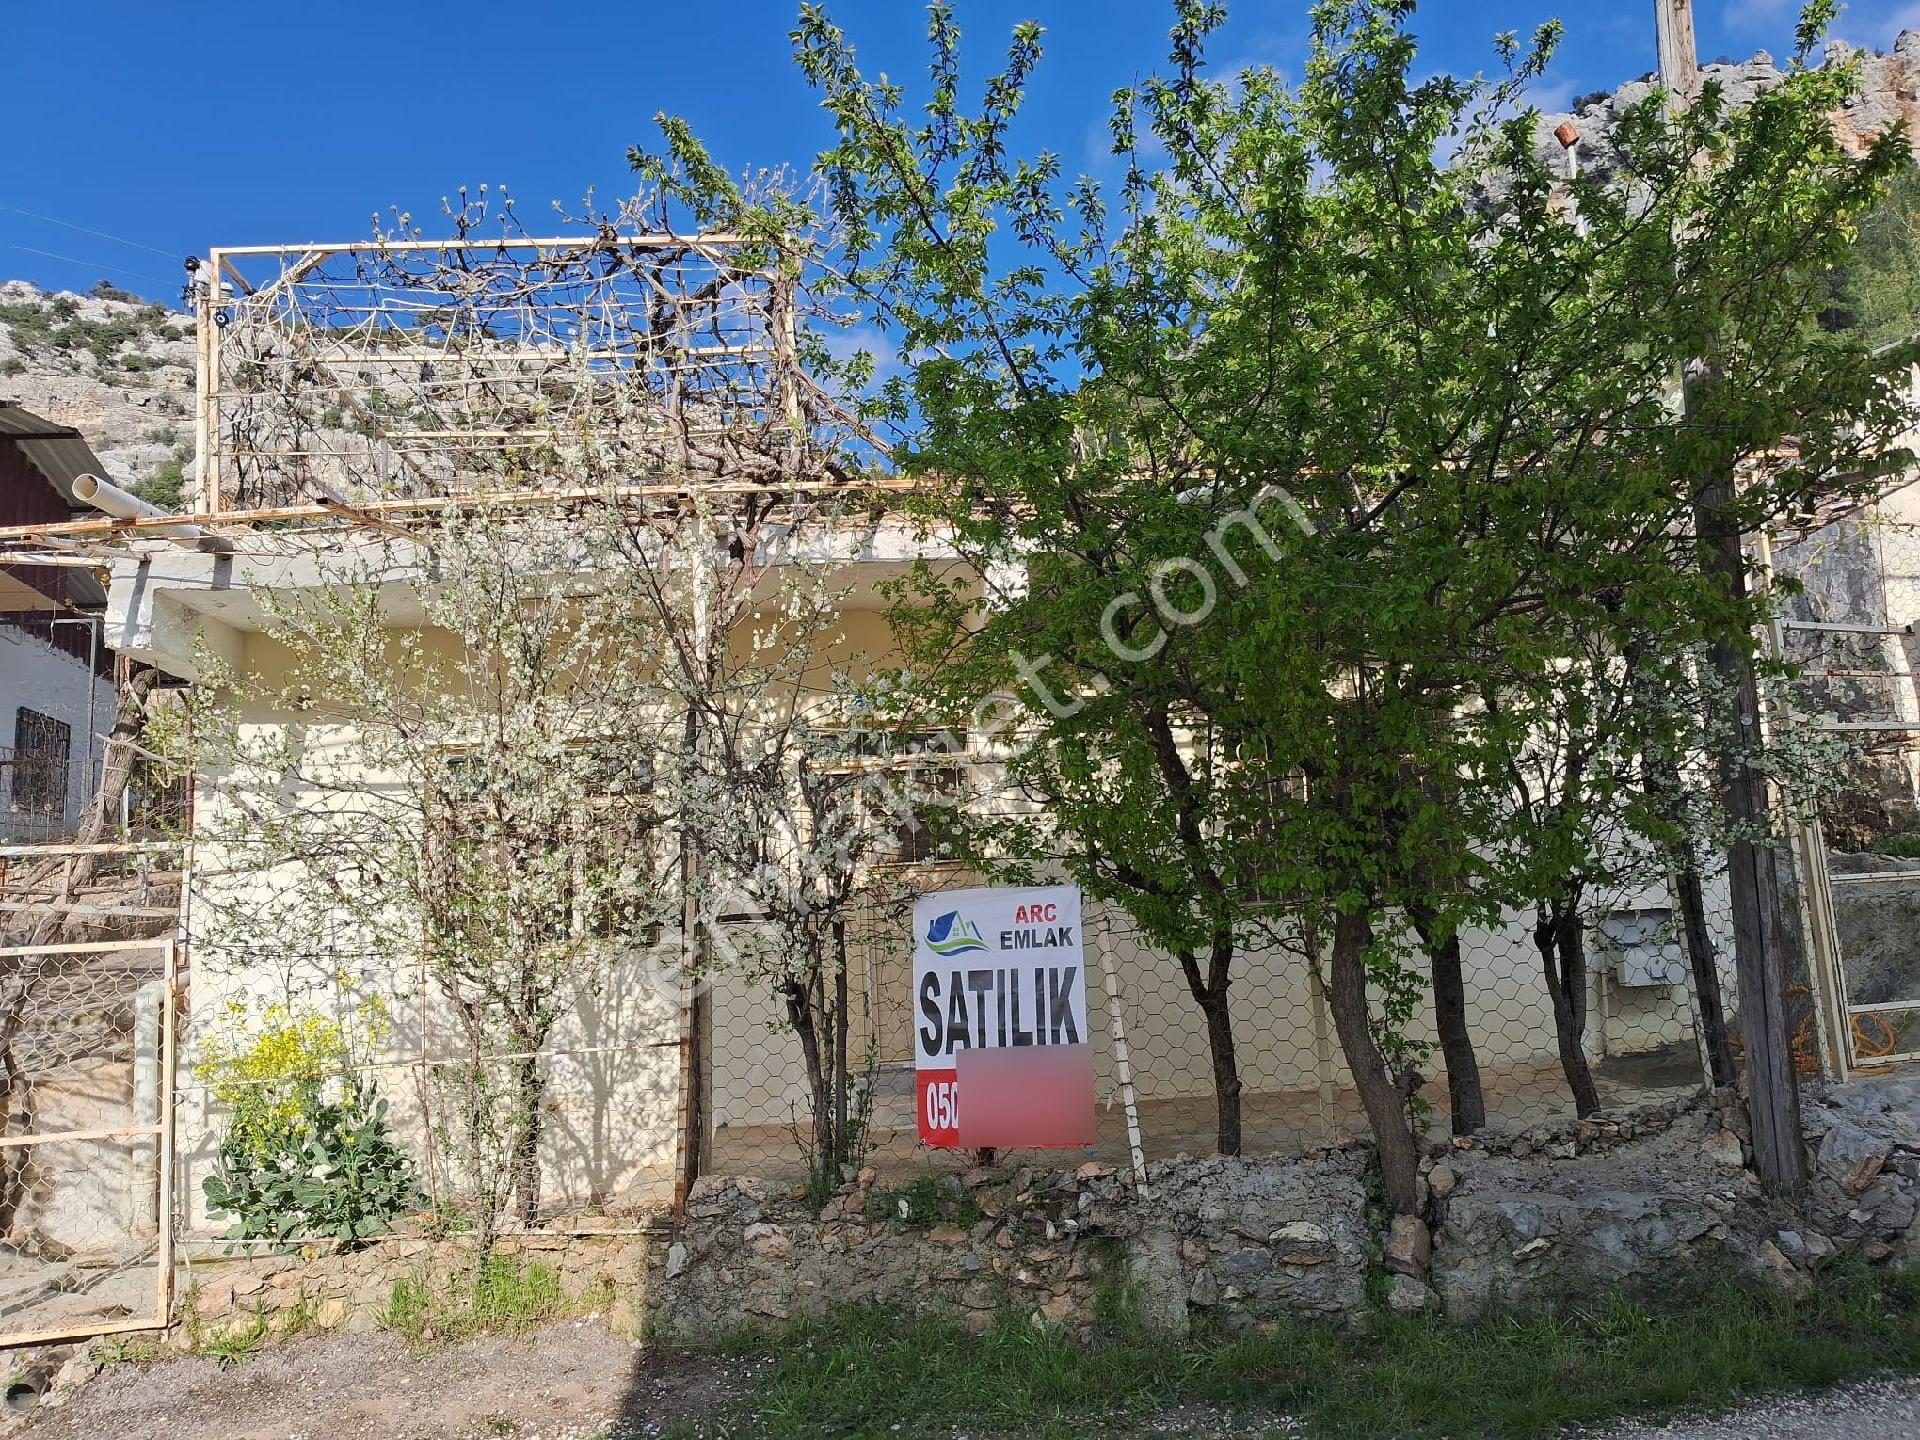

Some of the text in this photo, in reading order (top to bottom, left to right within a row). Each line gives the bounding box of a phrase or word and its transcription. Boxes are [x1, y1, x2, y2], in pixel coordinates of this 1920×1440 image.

[1015, 903, 1057, 924] ARC
[1000, 927, 1073, 950] EMLAK
[919, 966, 1079, 1057] SATILIK
